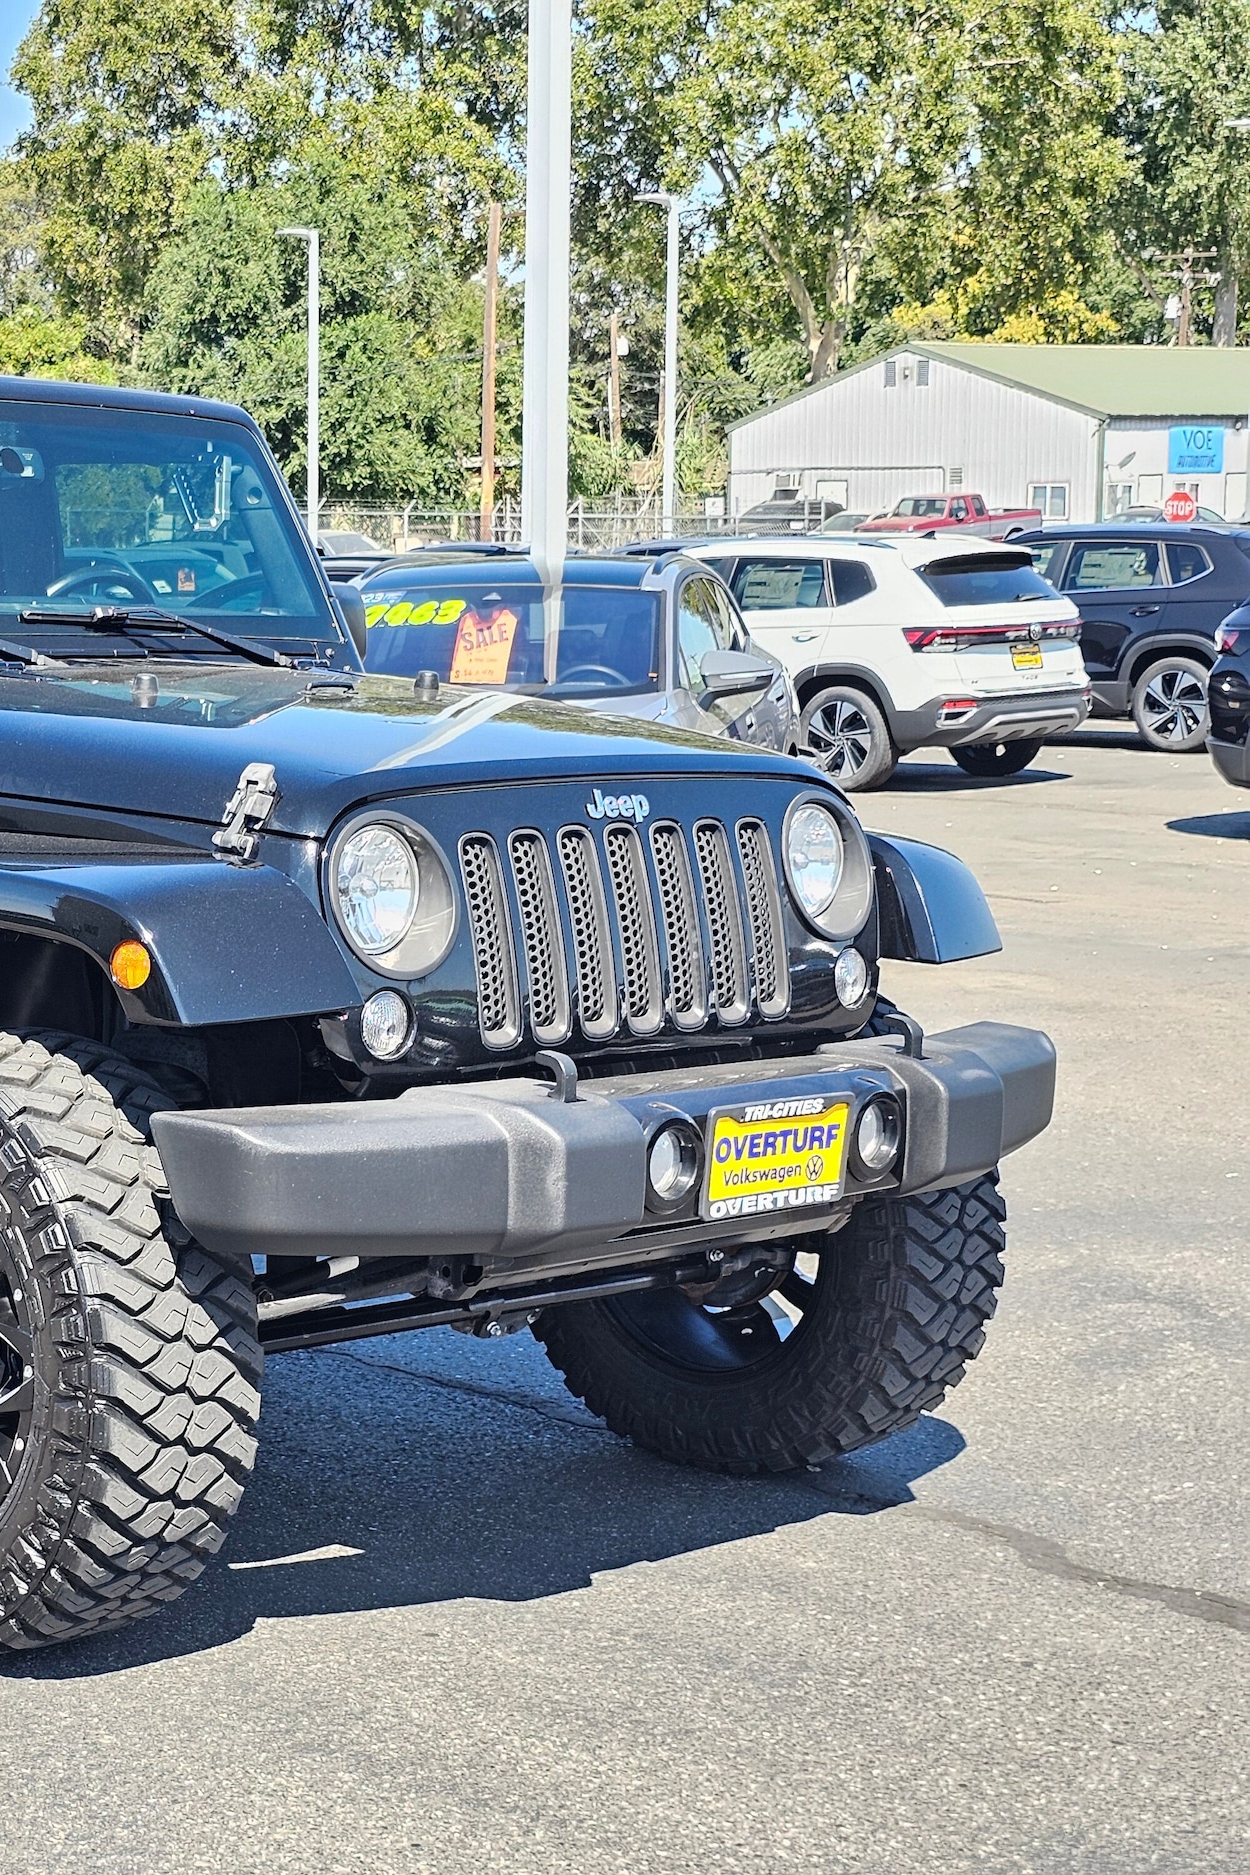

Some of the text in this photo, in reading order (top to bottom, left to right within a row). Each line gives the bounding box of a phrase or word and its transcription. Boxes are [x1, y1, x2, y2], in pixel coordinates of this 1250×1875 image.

[1182, 430, 1213, 451] VOE
[1165, 500, 1194, 517] STOP
[461, 623, 509, 652] SALE
[586, 788, 650, 823] Jeep
[743, 1097, 825, 1122] TRI-CITIES
[715, 1123, 841, 1164] OVERTURF
[723, 1163, 802, 1187] Volkswagen
[709, 1183, 840, 1219] OVERTURF
